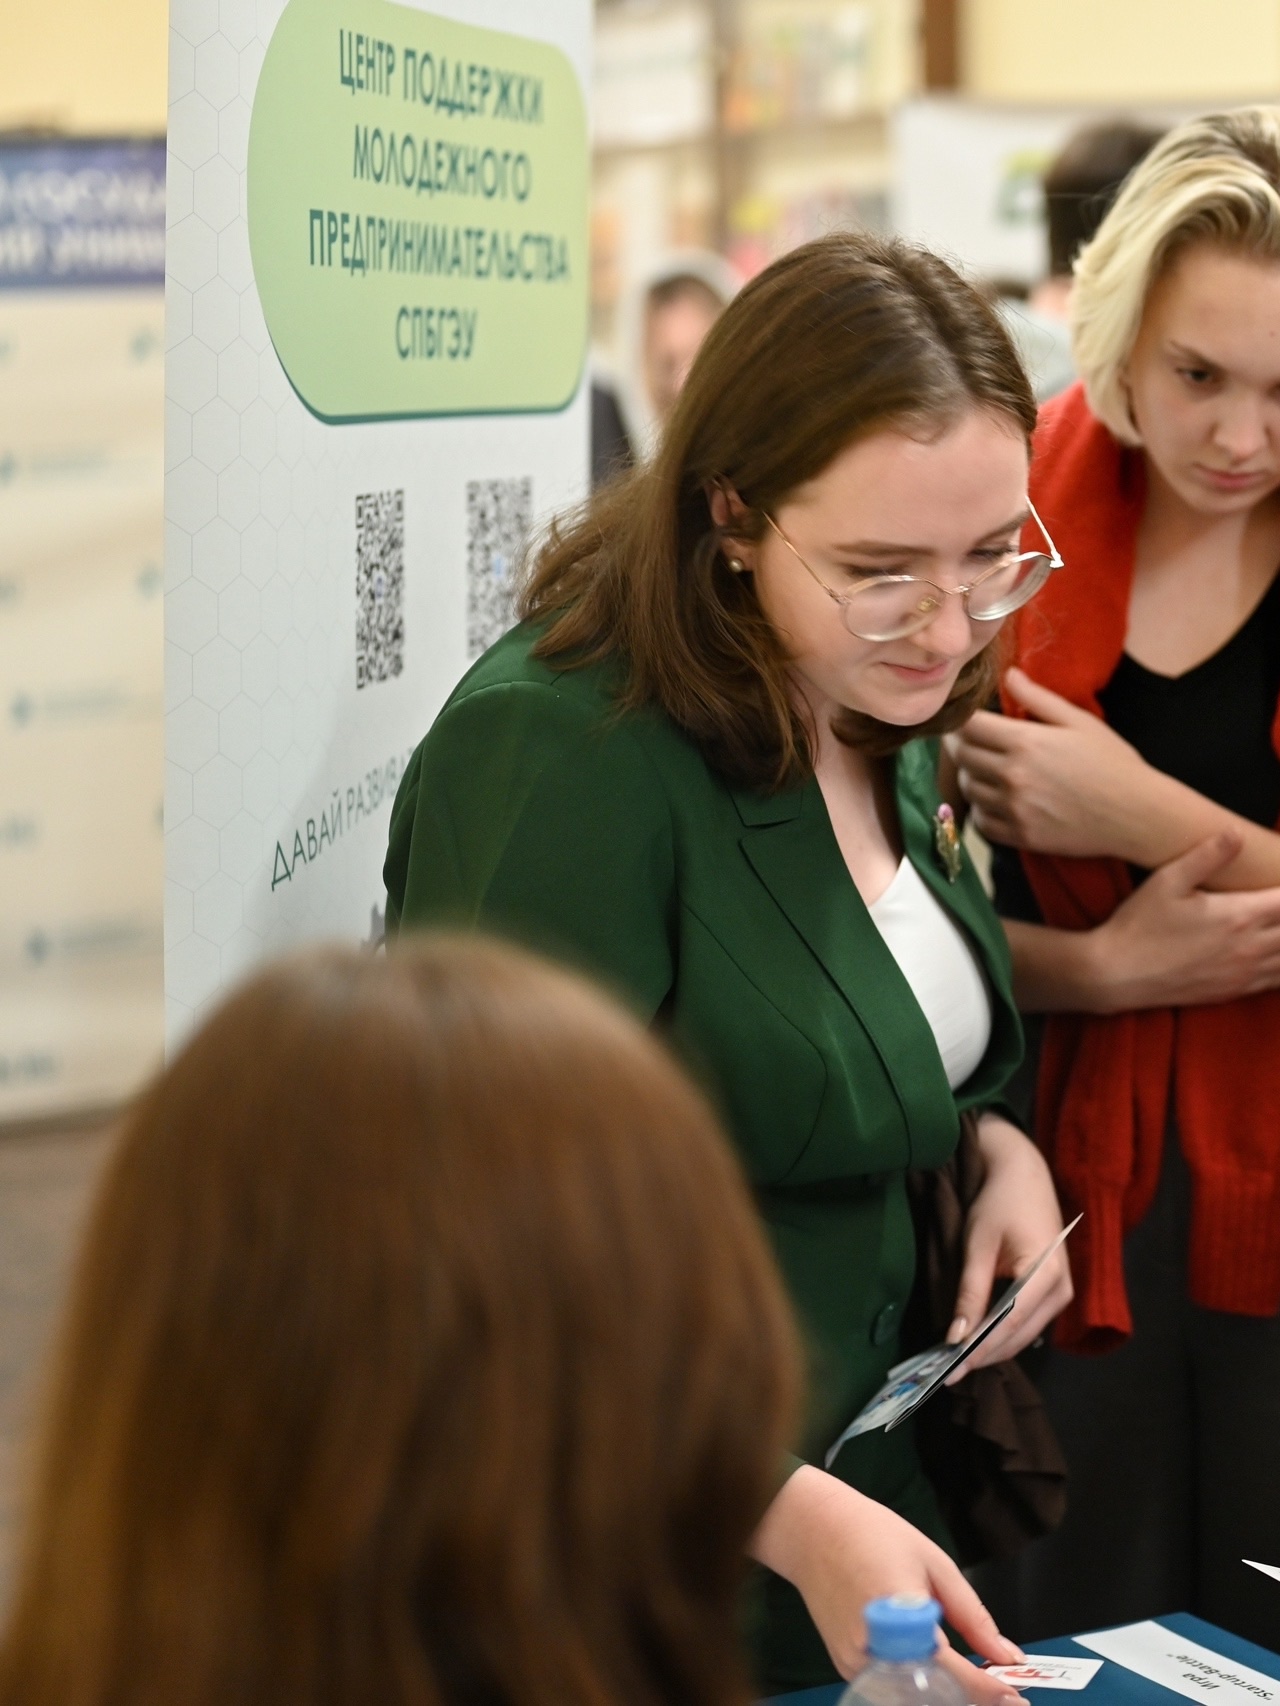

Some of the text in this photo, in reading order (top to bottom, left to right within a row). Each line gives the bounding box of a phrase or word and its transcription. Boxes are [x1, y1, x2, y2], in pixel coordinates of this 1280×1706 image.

[339, 28, 545, 126] ЦЕНТР ПОДДЕРЖКИ
[353, 124, 533, 203] МОЛОДЕЖНОГО
[309, 208, 571, 284] ПРЕДПРИНИМАТЕЛЬСТВА
[395, 305, 479, 361] СПБГЭУ
[271, 787, 344, 892] ДАВАЙ
[1182, 1672, 1220, 1691] Игра
